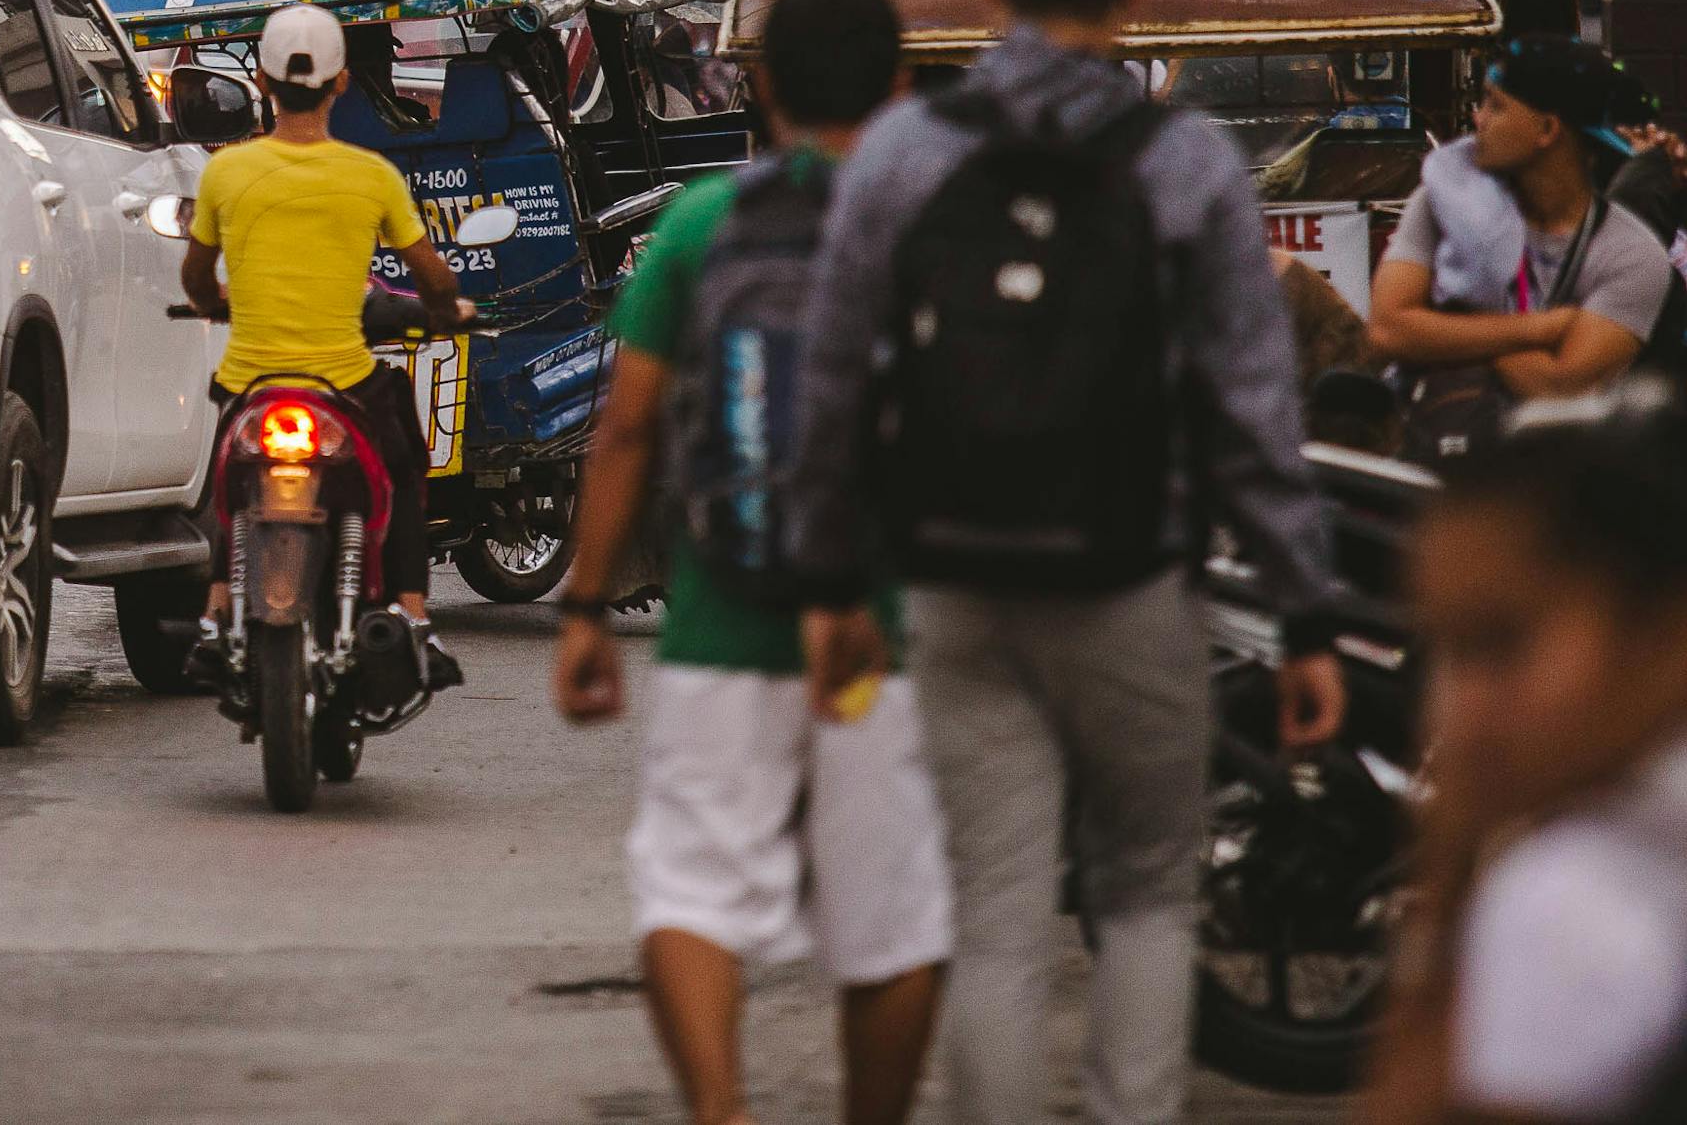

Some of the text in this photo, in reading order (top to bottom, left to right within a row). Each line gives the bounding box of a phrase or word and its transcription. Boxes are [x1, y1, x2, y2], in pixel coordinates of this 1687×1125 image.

[504, 184, 554, 199] HOW IS MY
[514, 197, 560, 211] DRIVING
[518, 211, 550, 223] ontact
[466, 248, 496, 272] 23
